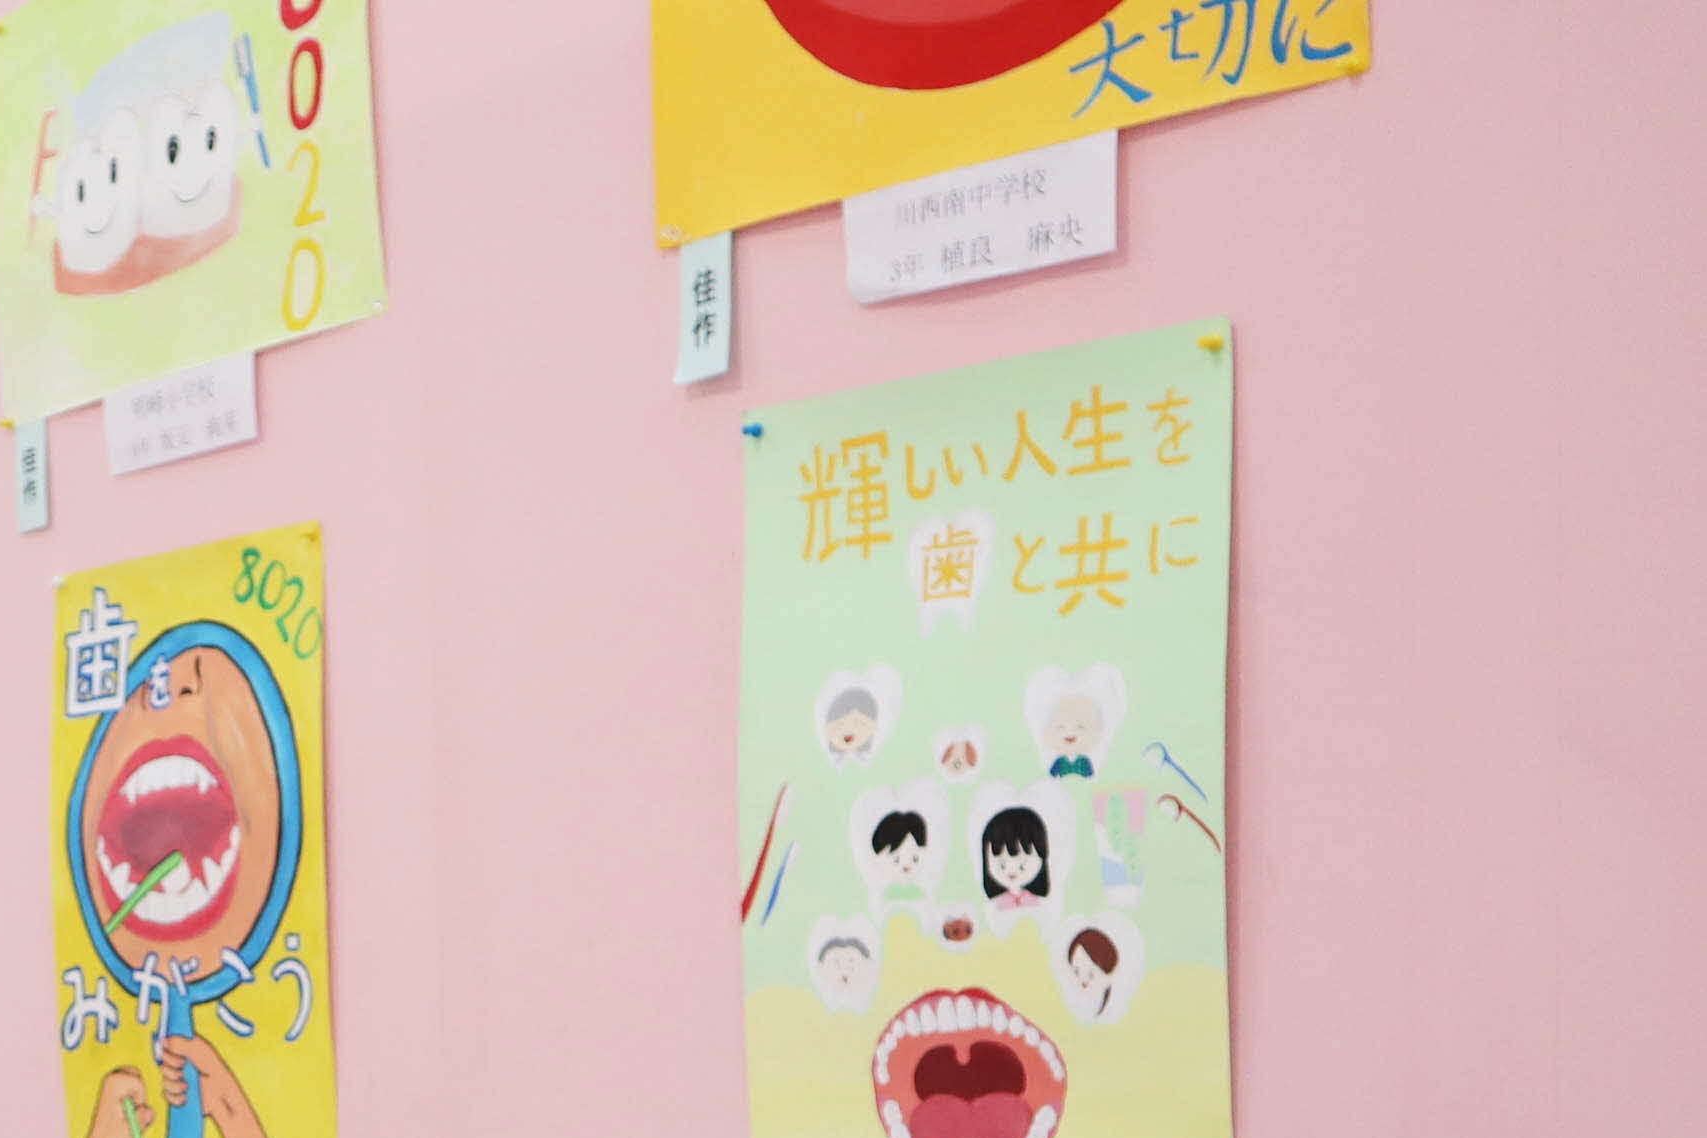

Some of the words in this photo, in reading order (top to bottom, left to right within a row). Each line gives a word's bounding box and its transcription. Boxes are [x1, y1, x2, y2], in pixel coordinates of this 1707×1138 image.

[1069, 0, 1353, 119] 大切に
[692, 268, 717, 352] 佳作
[798, 385, 1194, 562] 輝しい人生を
[232, 546, 323, 660] 8020
[921, 513, 1199, 616] 歯と共に
[61, 932, 314, 1066] みがこう
